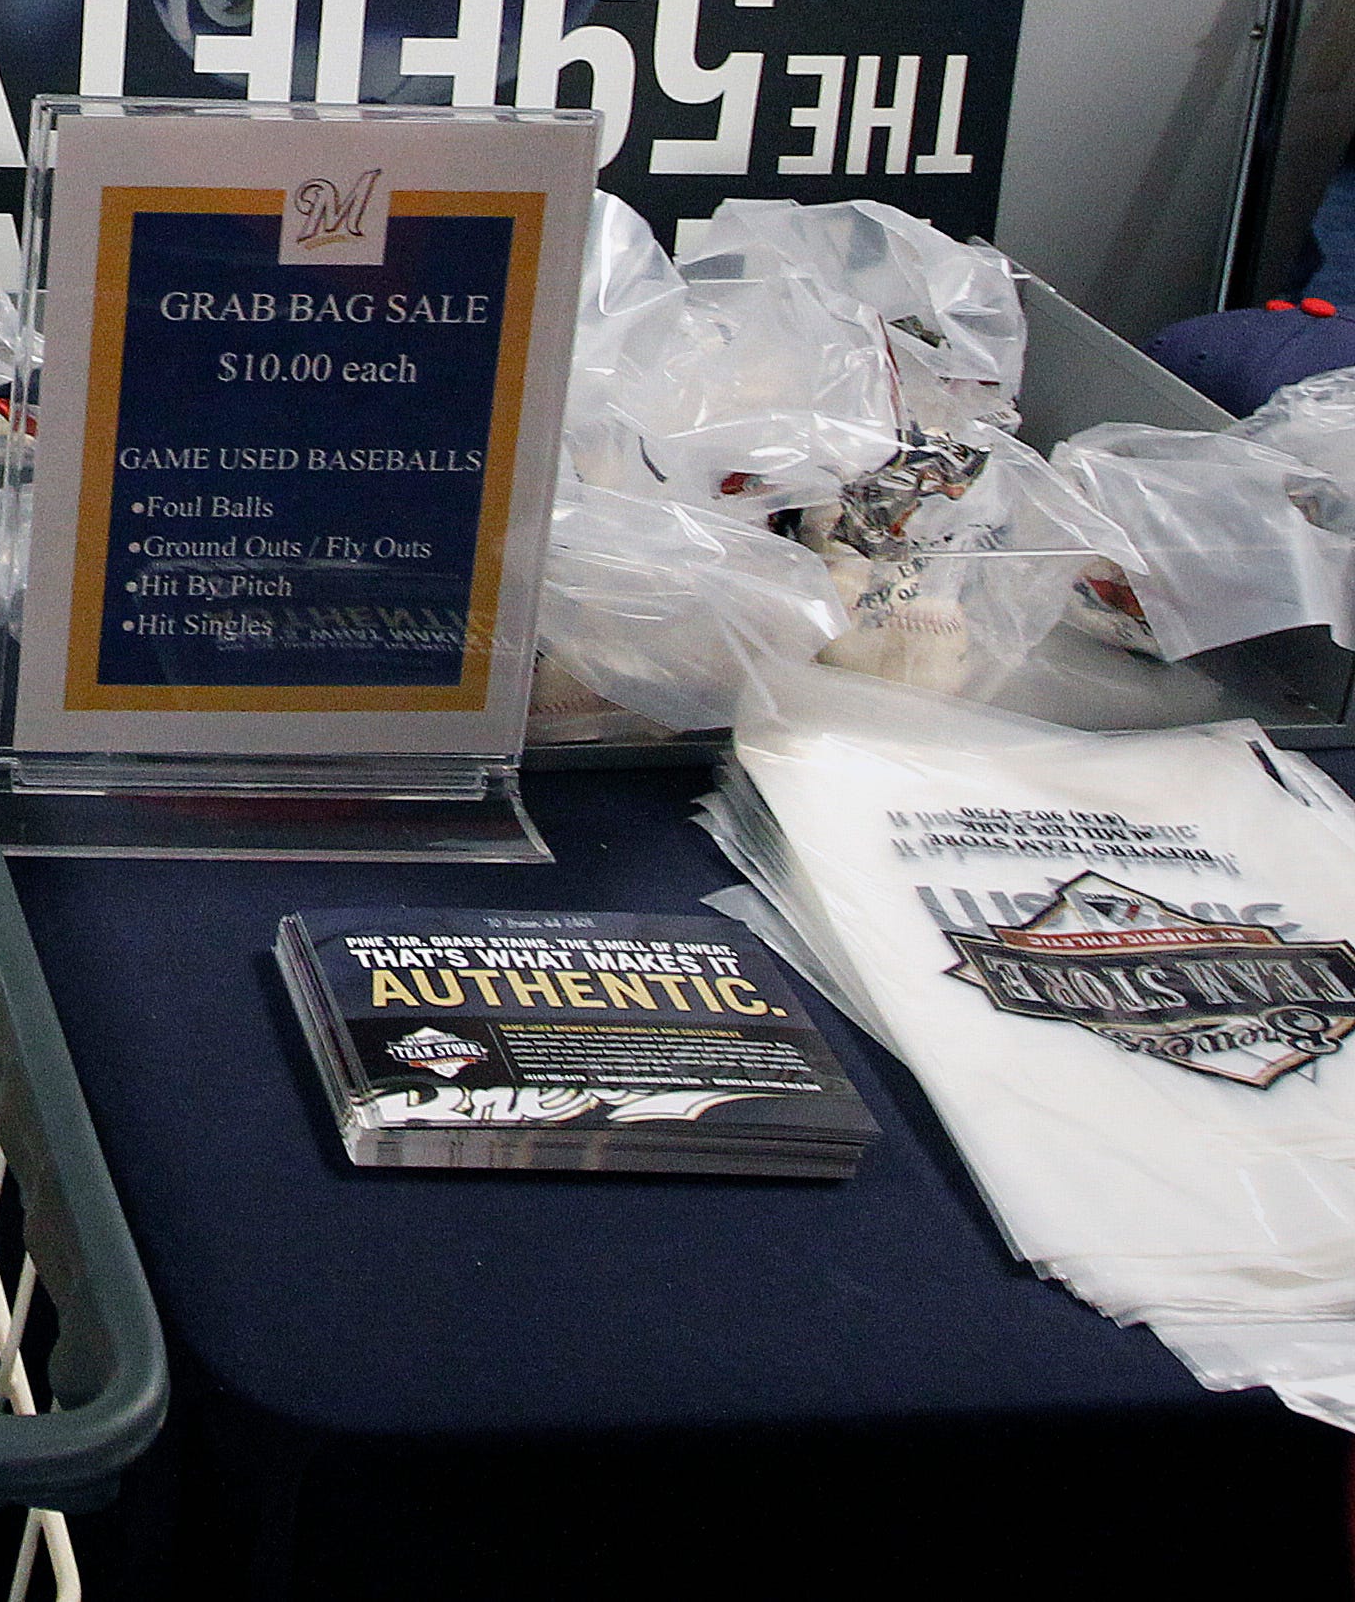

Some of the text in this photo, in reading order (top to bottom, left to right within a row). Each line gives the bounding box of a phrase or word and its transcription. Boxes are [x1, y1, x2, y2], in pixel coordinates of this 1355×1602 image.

[778, 53, 974, 175] THE
[159, 291, 490, 324] GRAB BAG SALE
[217, 352, 418, 384] $10.00 each
[119, 447, 483, 473] GAME USED BASEBALLS
[146, 496, 275, 519] Foul Balls
[144, 536, 237, 559] Ground
[244, 536, 303, 559] Outs
[326, 537, 368, 566] Fly
[374, 537, 433, 559] Outs
[139, 575, 292, 601] Hit By Pitch
[135, 613, 177, 637] Hit
[184, 613, 274, 642] Singles
[958, 817, 1029, 837] PARK
[1029, 822, 1132, 842] MILLER
[928, 831, 1005, 851] STORE
[1012, 836, 1087, 855] TEAM
[1095, 843, 1215, 863] BREWERS
[344, 936, 740, 958] PINE TAR. GRASS STAINS. THE SMELL OF SWEAT.
[1027, 931, 1118, 949] ATHLETIC
[349, 948, 743, 977] THAT'S WHAT MAKES IT
[372, 969, 789, 1018] AUTHENTIC.
[985, 954, 1355, 1014] TEAM STORE
[1101, 1005, 1343, 1057] Brewers
[392, 1042, 483, 1059] TEAM STORE
